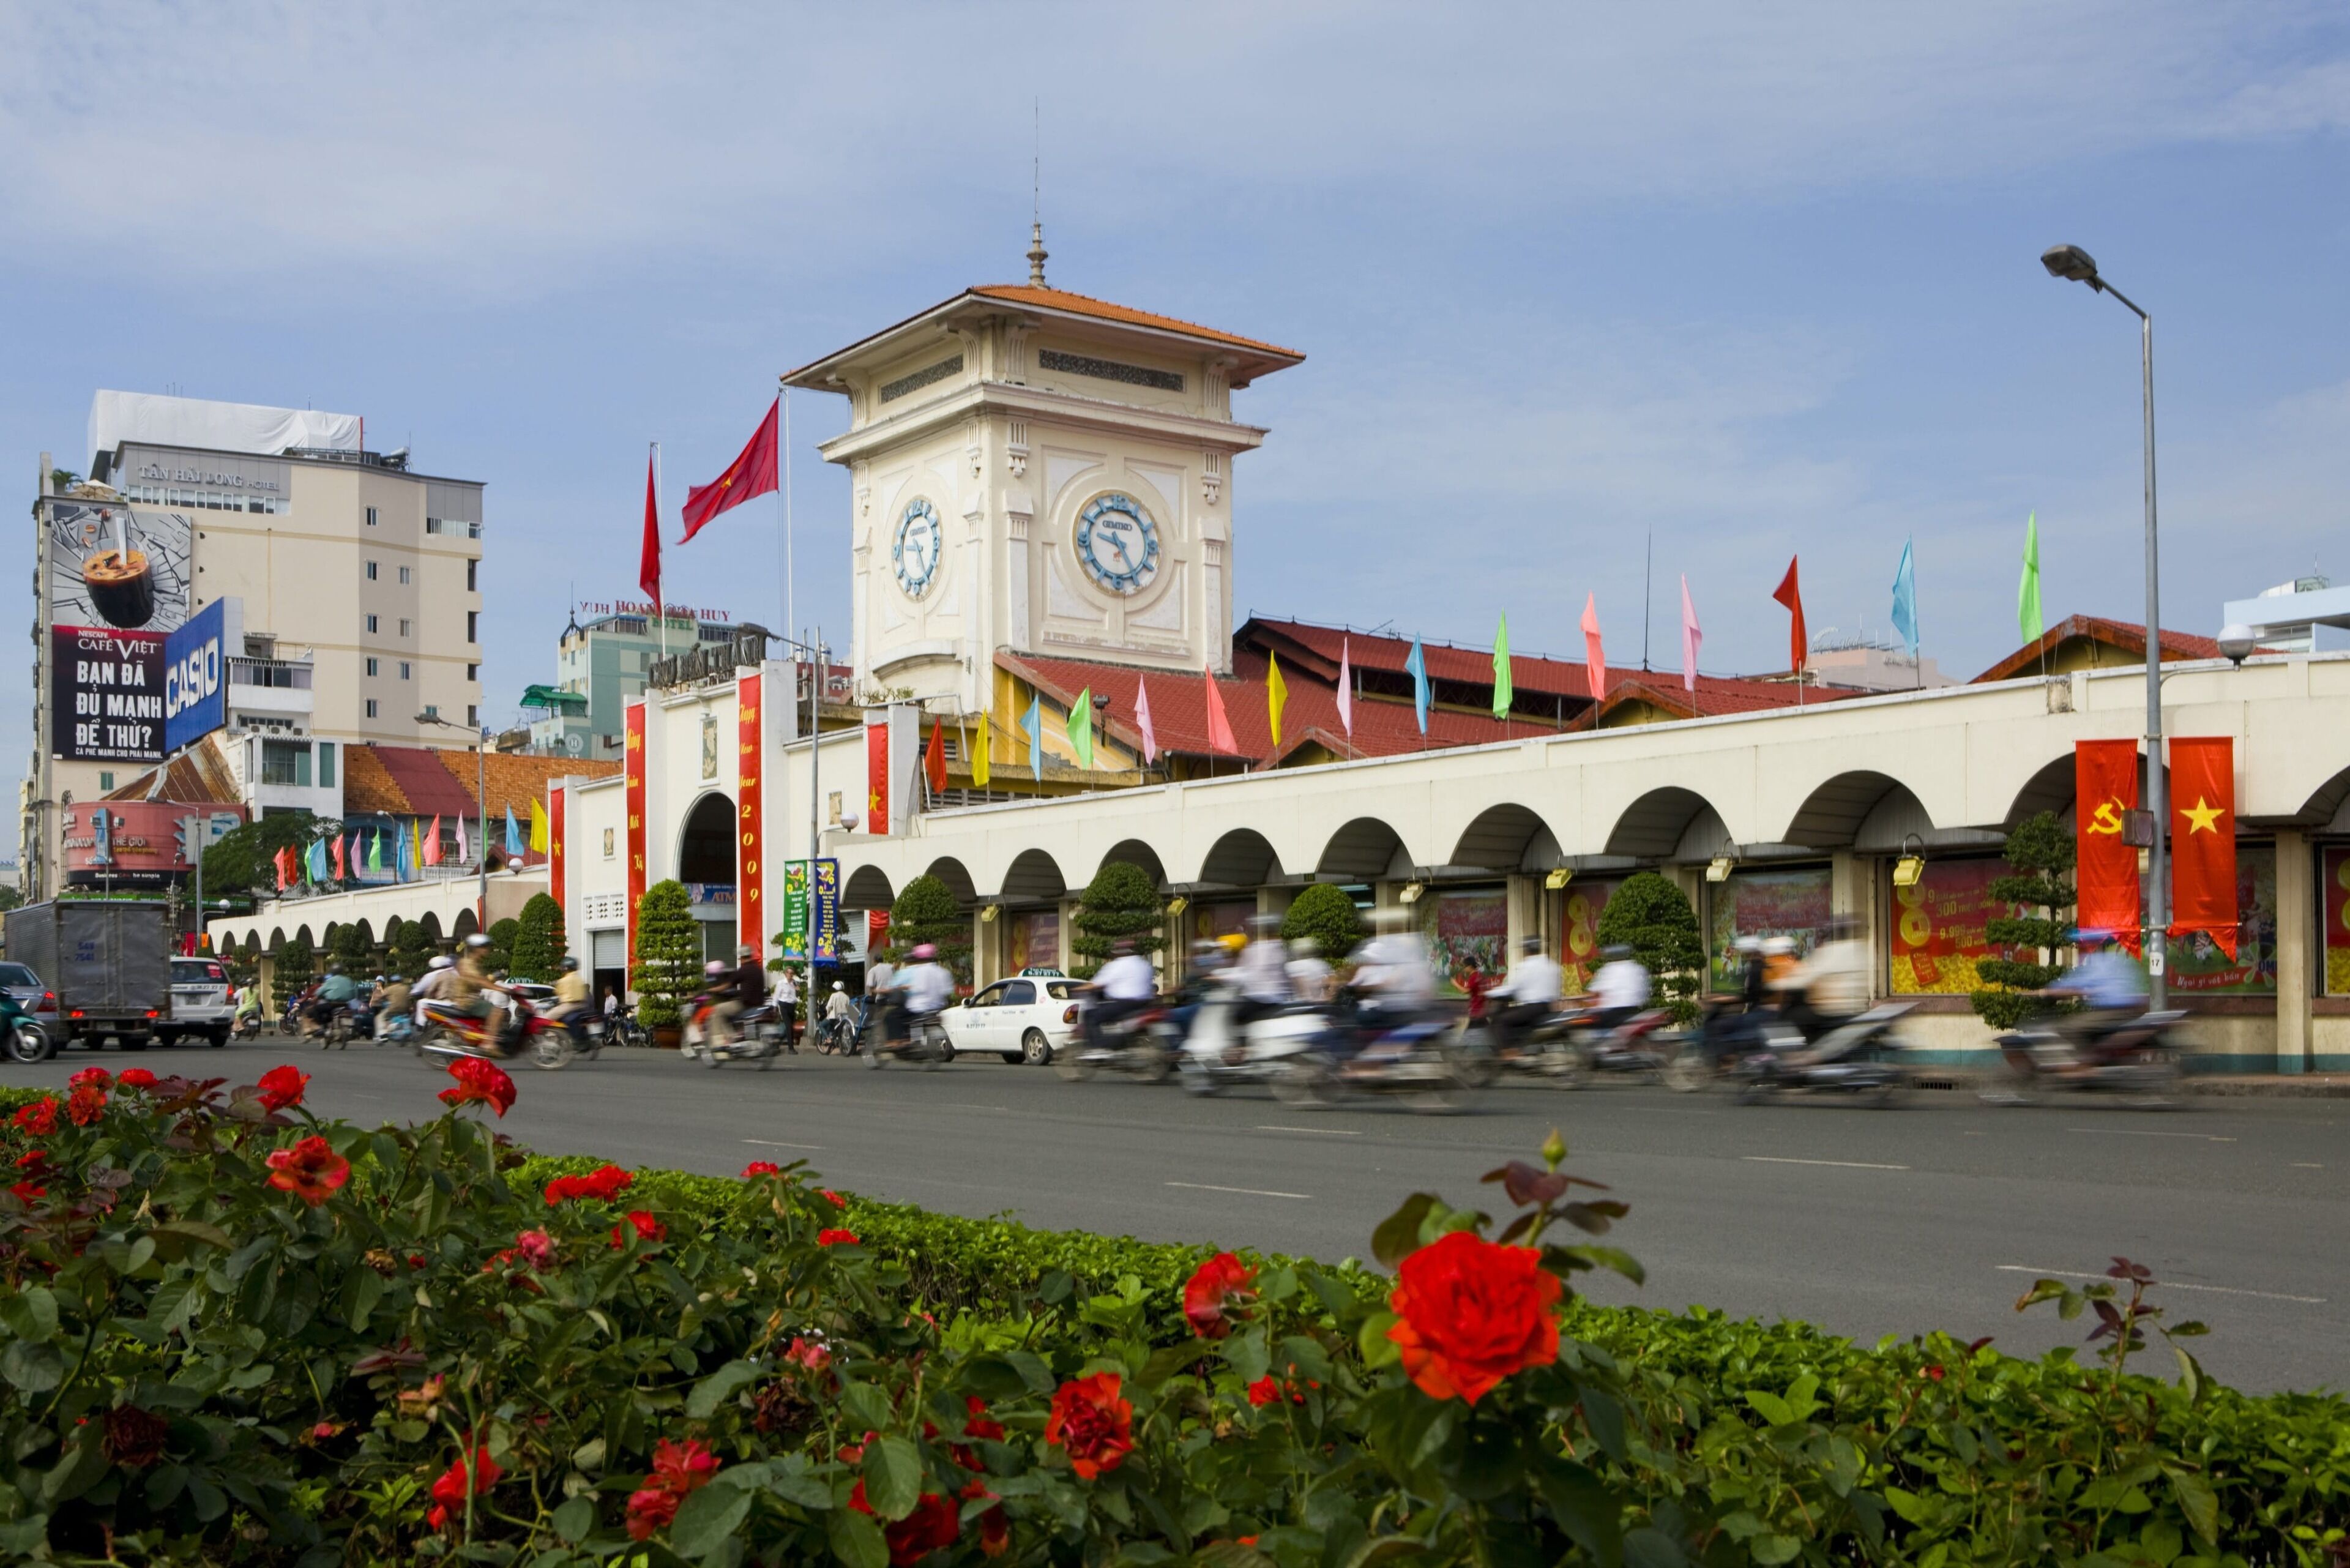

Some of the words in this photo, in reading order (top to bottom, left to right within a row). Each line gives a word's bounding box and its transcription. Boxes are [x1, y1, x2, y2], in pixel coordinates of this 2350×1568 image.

[205, 472, 243, 487] LONG
[247, 480, 279, 491] HOTEL
[615, 600, 658, 614] HOAN
[701, 608, 730, 621] HUY
[78, 638, 113, 651] CAFÉ
[77, 661, 114, 687] BẠN
[121, 660, 145, 686] ĐÃ
[166, 637, 218, 719] CASIO
[76, 687, 100, 715] ĐỦ
[107, 694, 162, 720] MẠNH
[76, 718, 100, 745] ĐỂ
[107, 720, 152, 748] THỬ?
[1936, 901, 1956, 917] 300
[2259, 960, 2277, 971] OM
